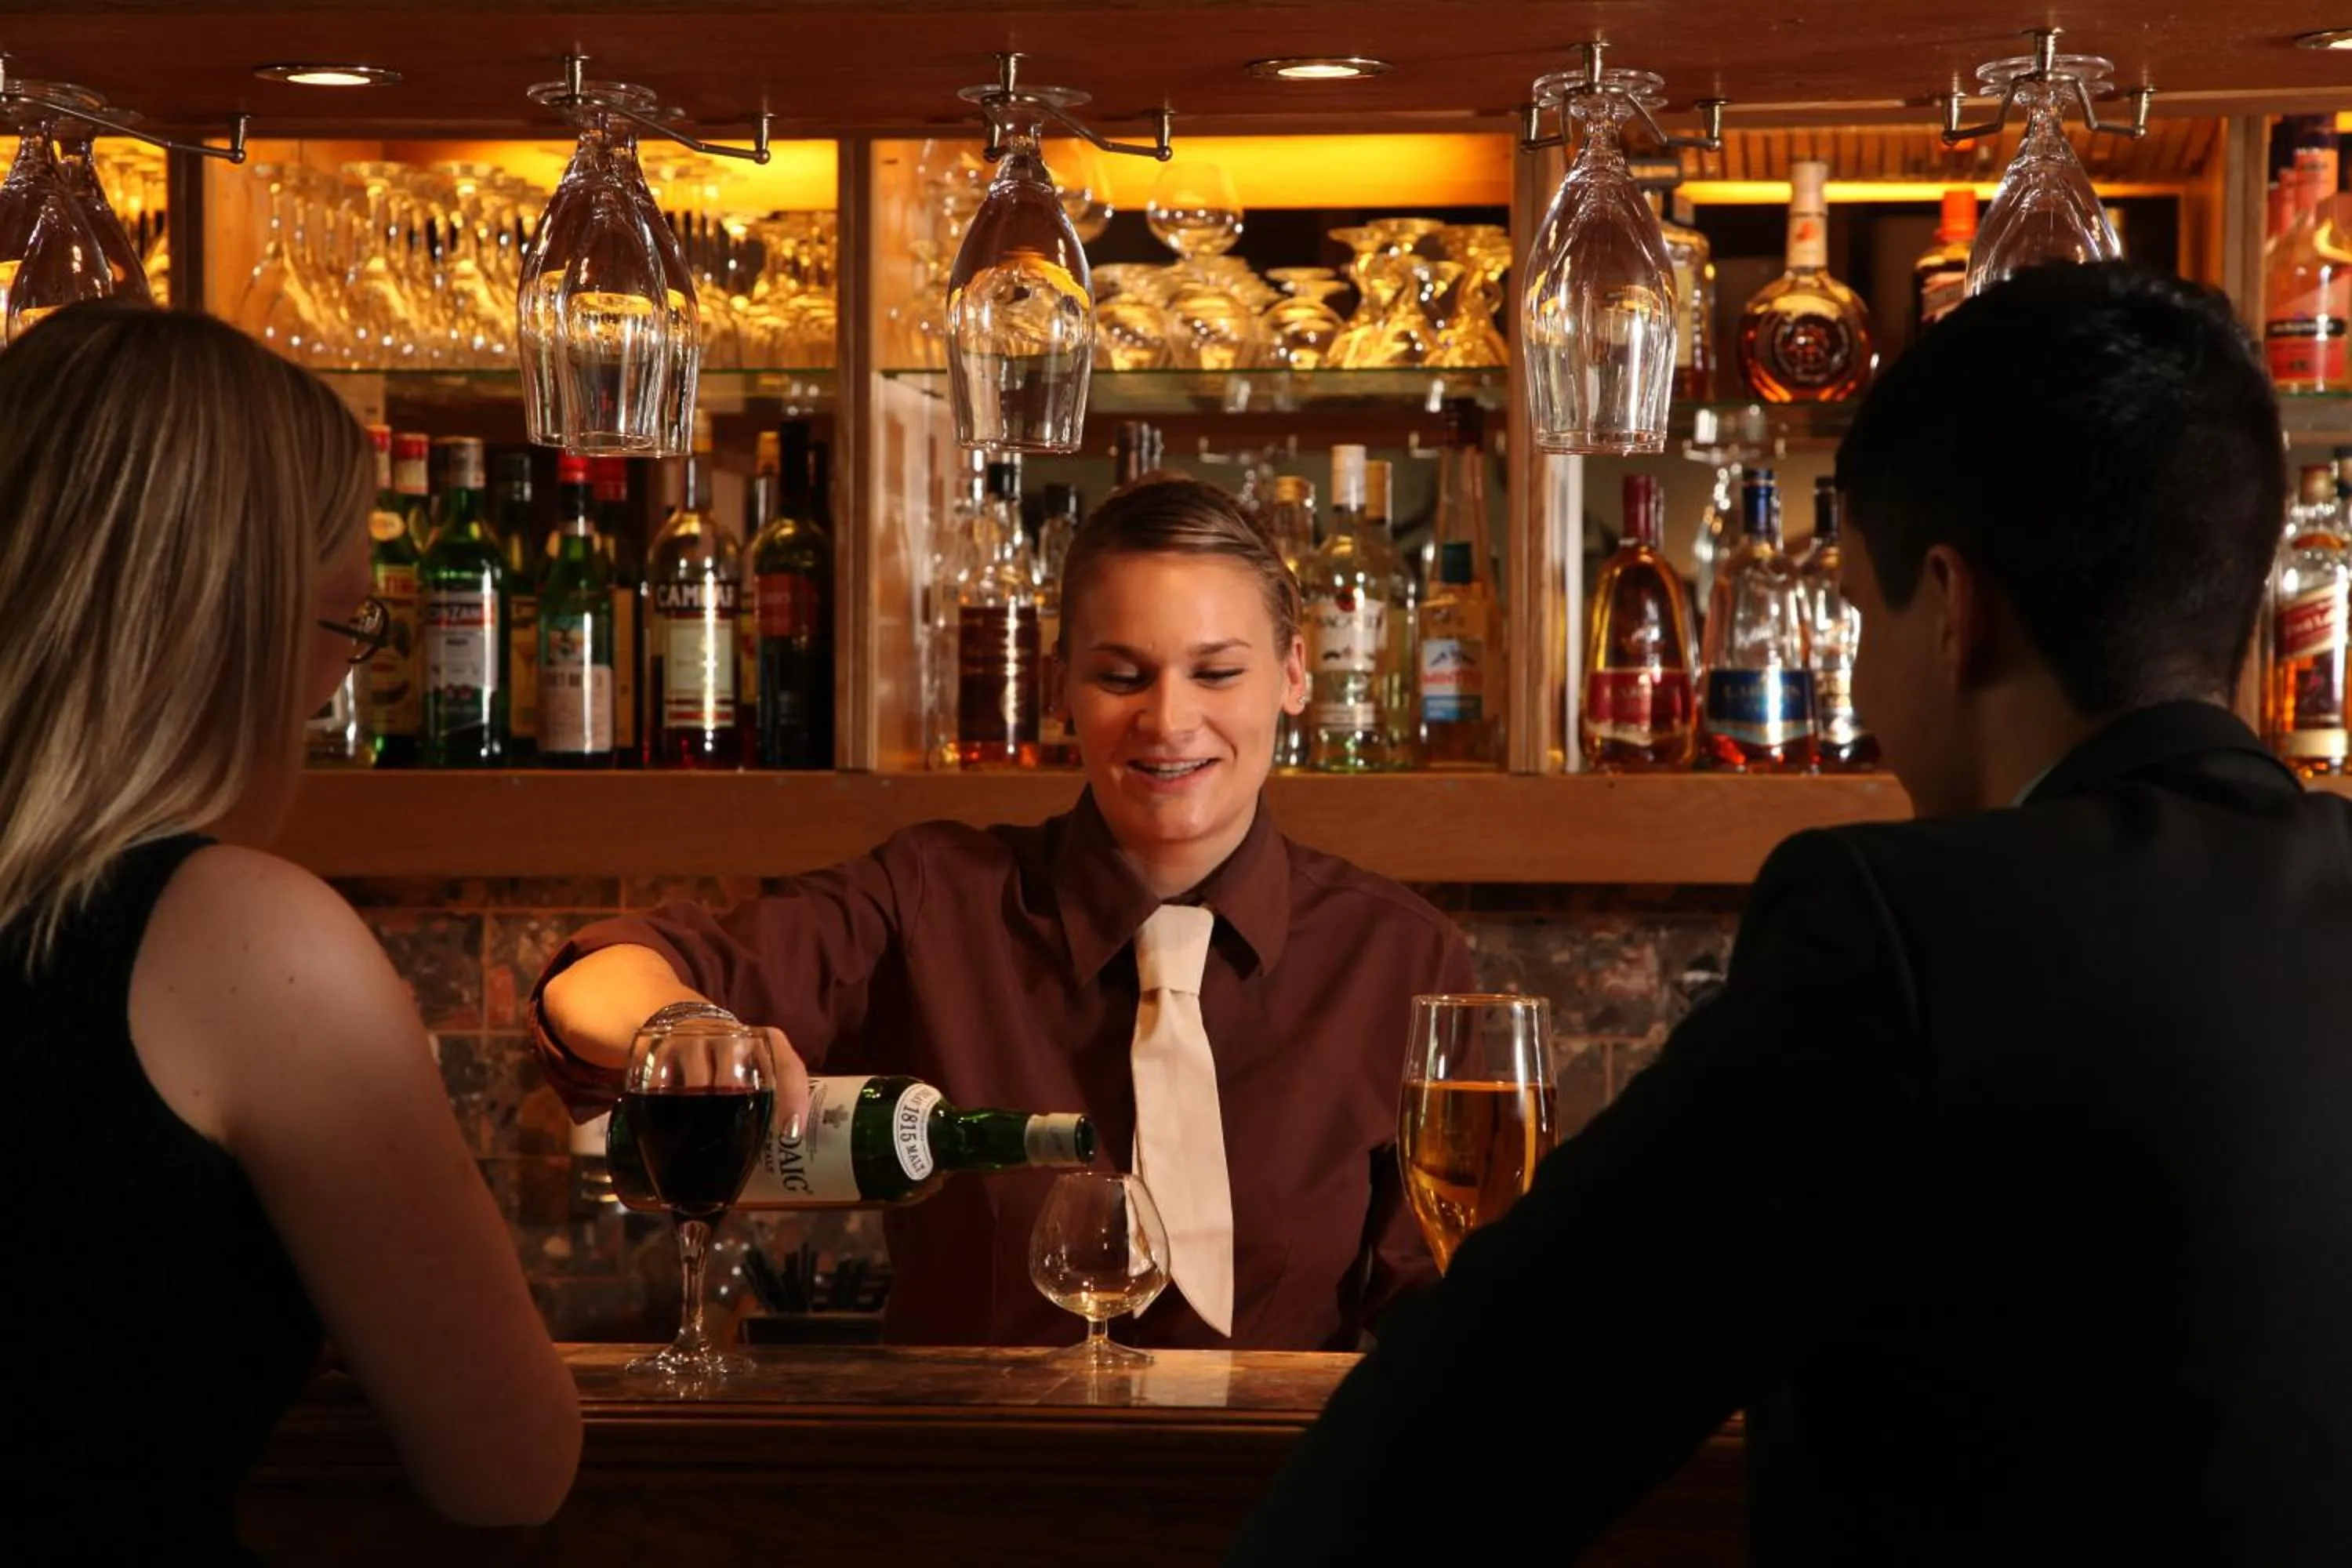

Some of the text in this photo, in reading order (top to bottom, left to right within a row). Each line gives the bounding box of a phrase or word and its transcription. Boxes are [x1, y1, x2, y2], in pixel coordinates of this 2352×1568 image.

[657, 583, 735, 608] CAMAR
[899, 1105, 920, 1142] 1815
[906, 1145, 925, 1173] MALT
